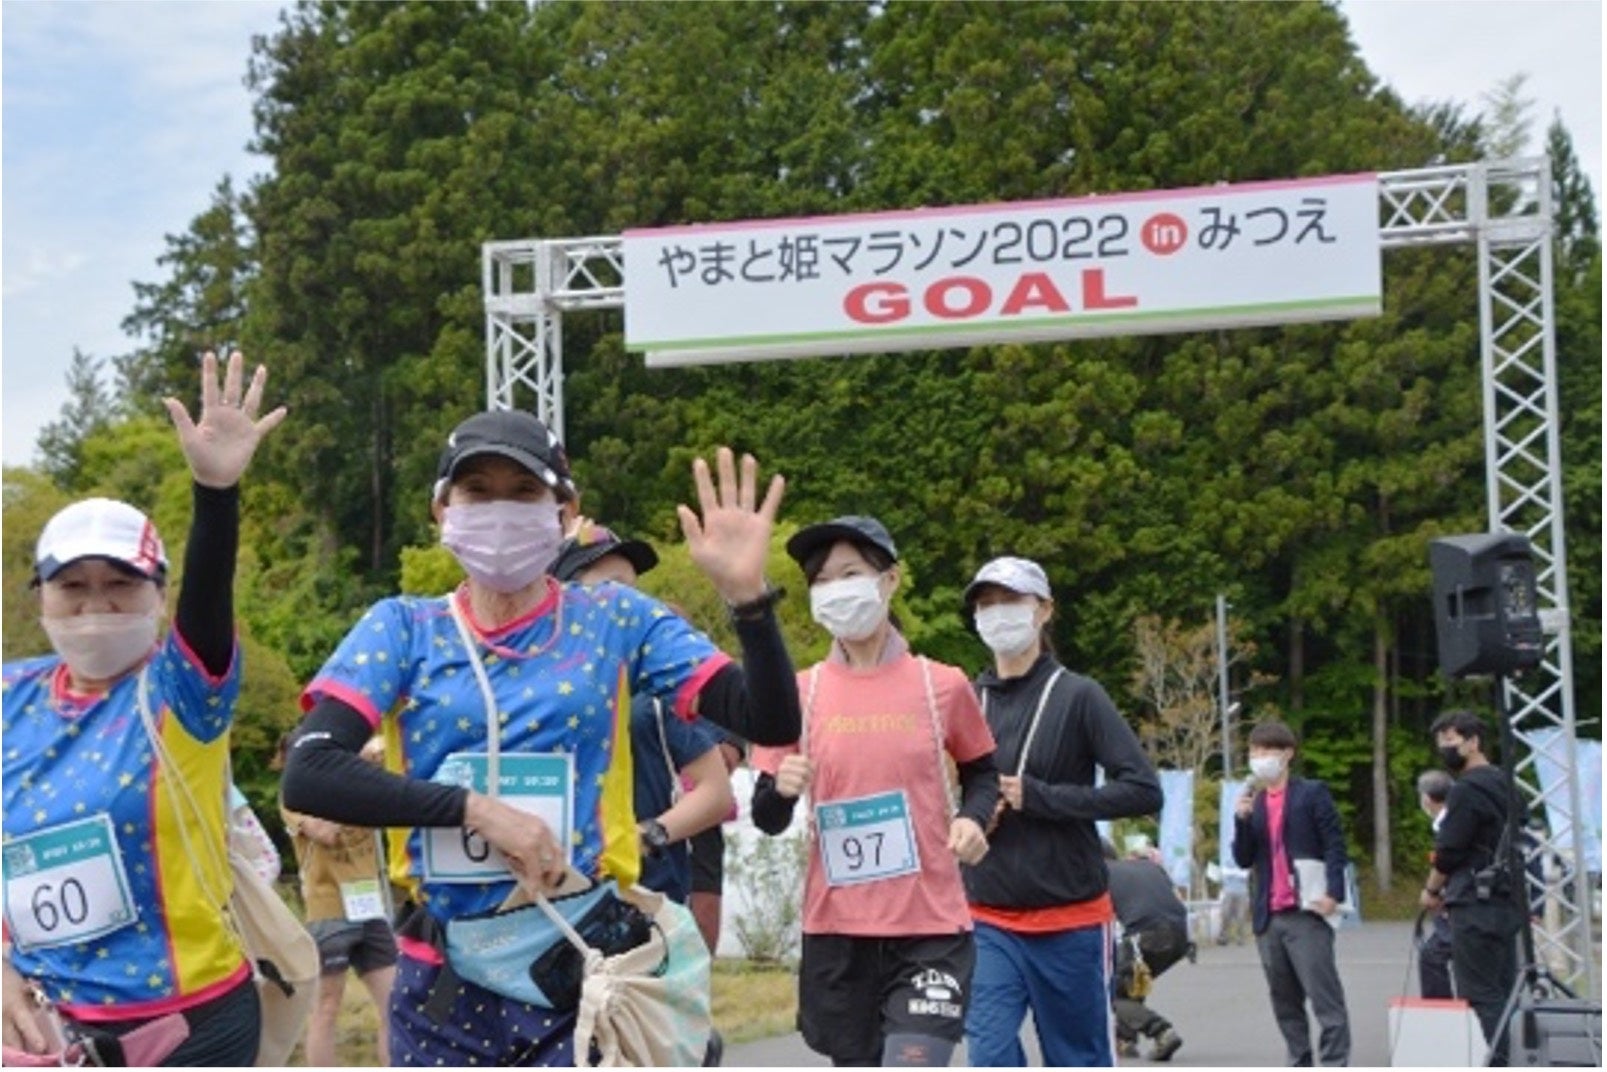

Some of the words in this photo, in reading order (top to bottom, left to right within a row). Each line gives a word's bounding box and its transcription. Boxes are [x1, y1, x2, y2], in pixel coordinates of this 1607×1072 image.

[1150, 221, 1180, 247] in
[1199, 198, 1336, 250] みつえ
[843, 269, 1138, 323] GOAL
[843, 832, 884, 870] 97
[31, 877, 88, 931] 60
